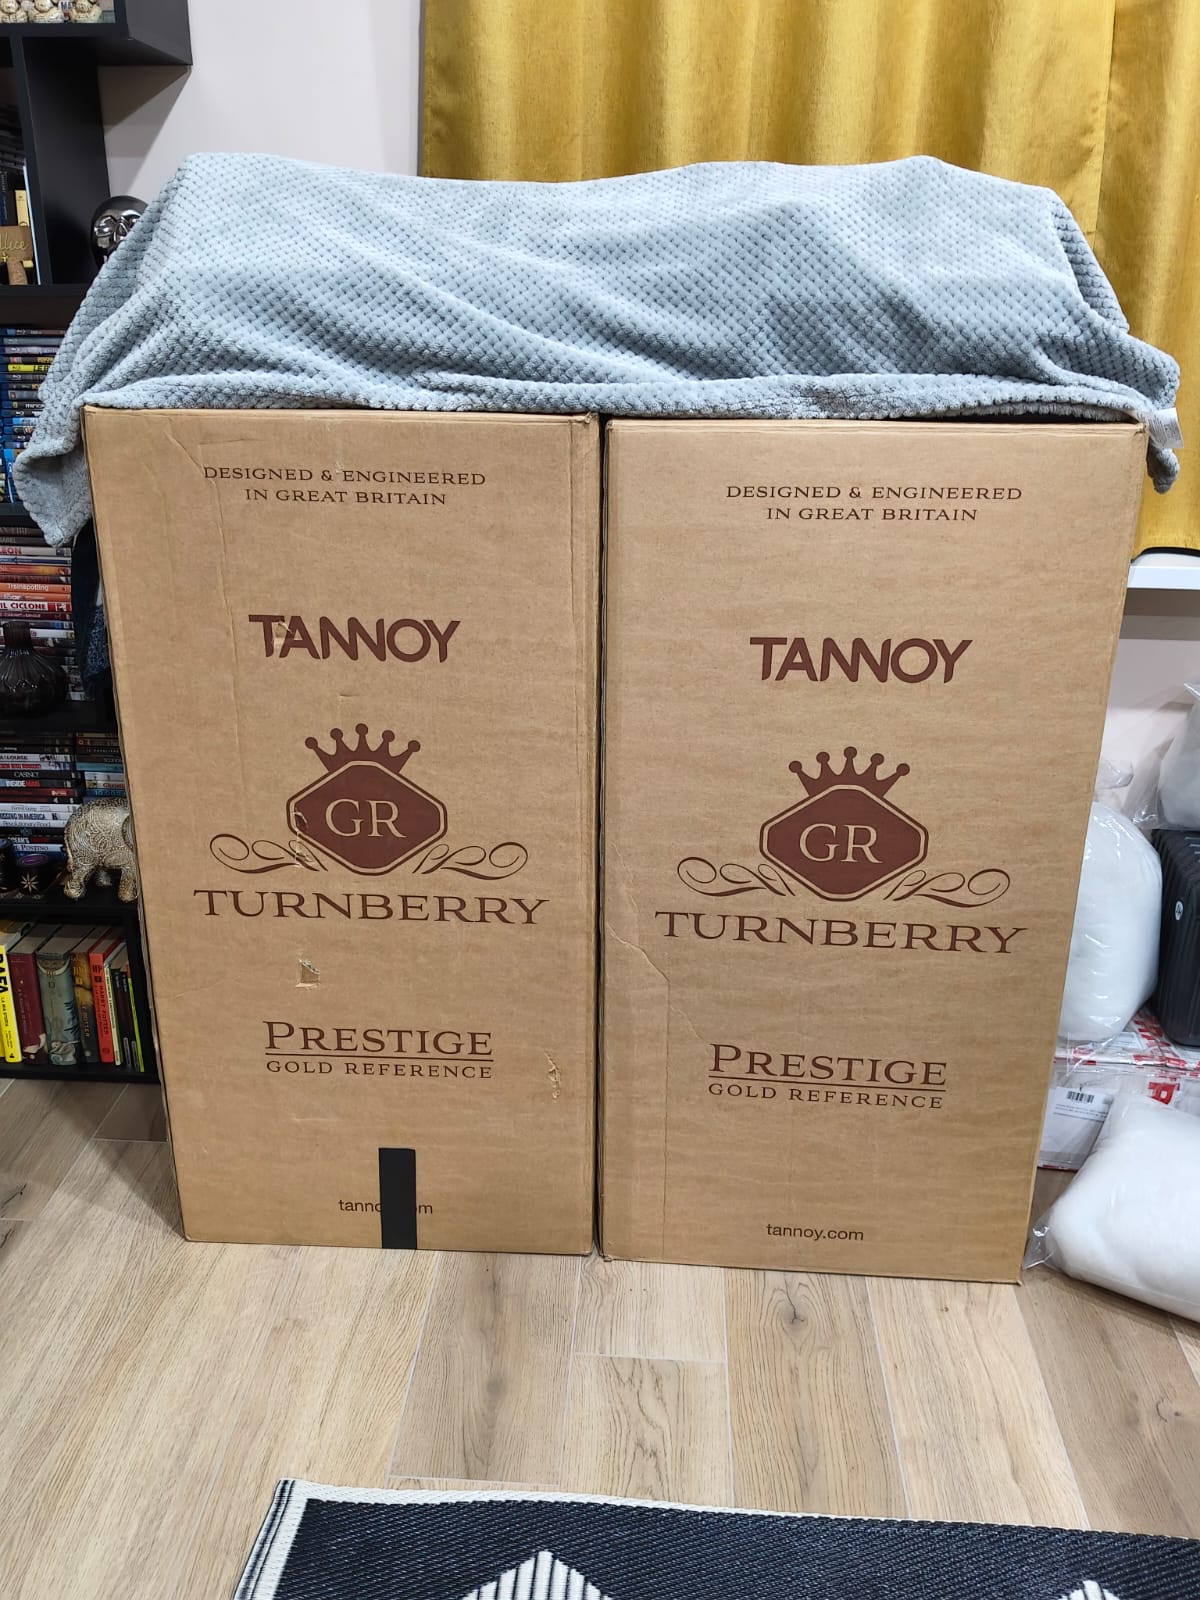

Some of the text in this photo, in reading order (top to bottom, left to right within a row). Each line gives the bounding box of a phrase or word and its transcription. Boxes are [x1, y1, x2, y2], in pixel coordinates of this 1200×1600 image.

[204, 467, 485, 485] DESIGNED & ENGINEERED
[246, 489, 445, 504] IN GREAT BRITAIN
[727, 486, 1021, 499] DESIGNED & ENGINEERED
[768, 508, 976, 520] IN GREAT BRITAIN
[10, 602, 46, 610] CICLONE
[248, 615, 461, 663] TANNOY
[750, 637, 973, 683] TANNOY
[324, 798, 407, 838] GR
[799, 823, 883, 864] GR
[194, 890, 549, 924] TURNBERRY
[655, 911, 1028, 953] TURNBERRY
[263, 1021, 493, 1056] PRESTIGE
[267, 1060, 494, 1078] GOLD REFERENCE
[708, 1043, 947, 1085] PRESTIGE
[709, 1084, 945, 1108] GOLD REFERENCE
[767, 1224, 863, 1241] tannoy.com
